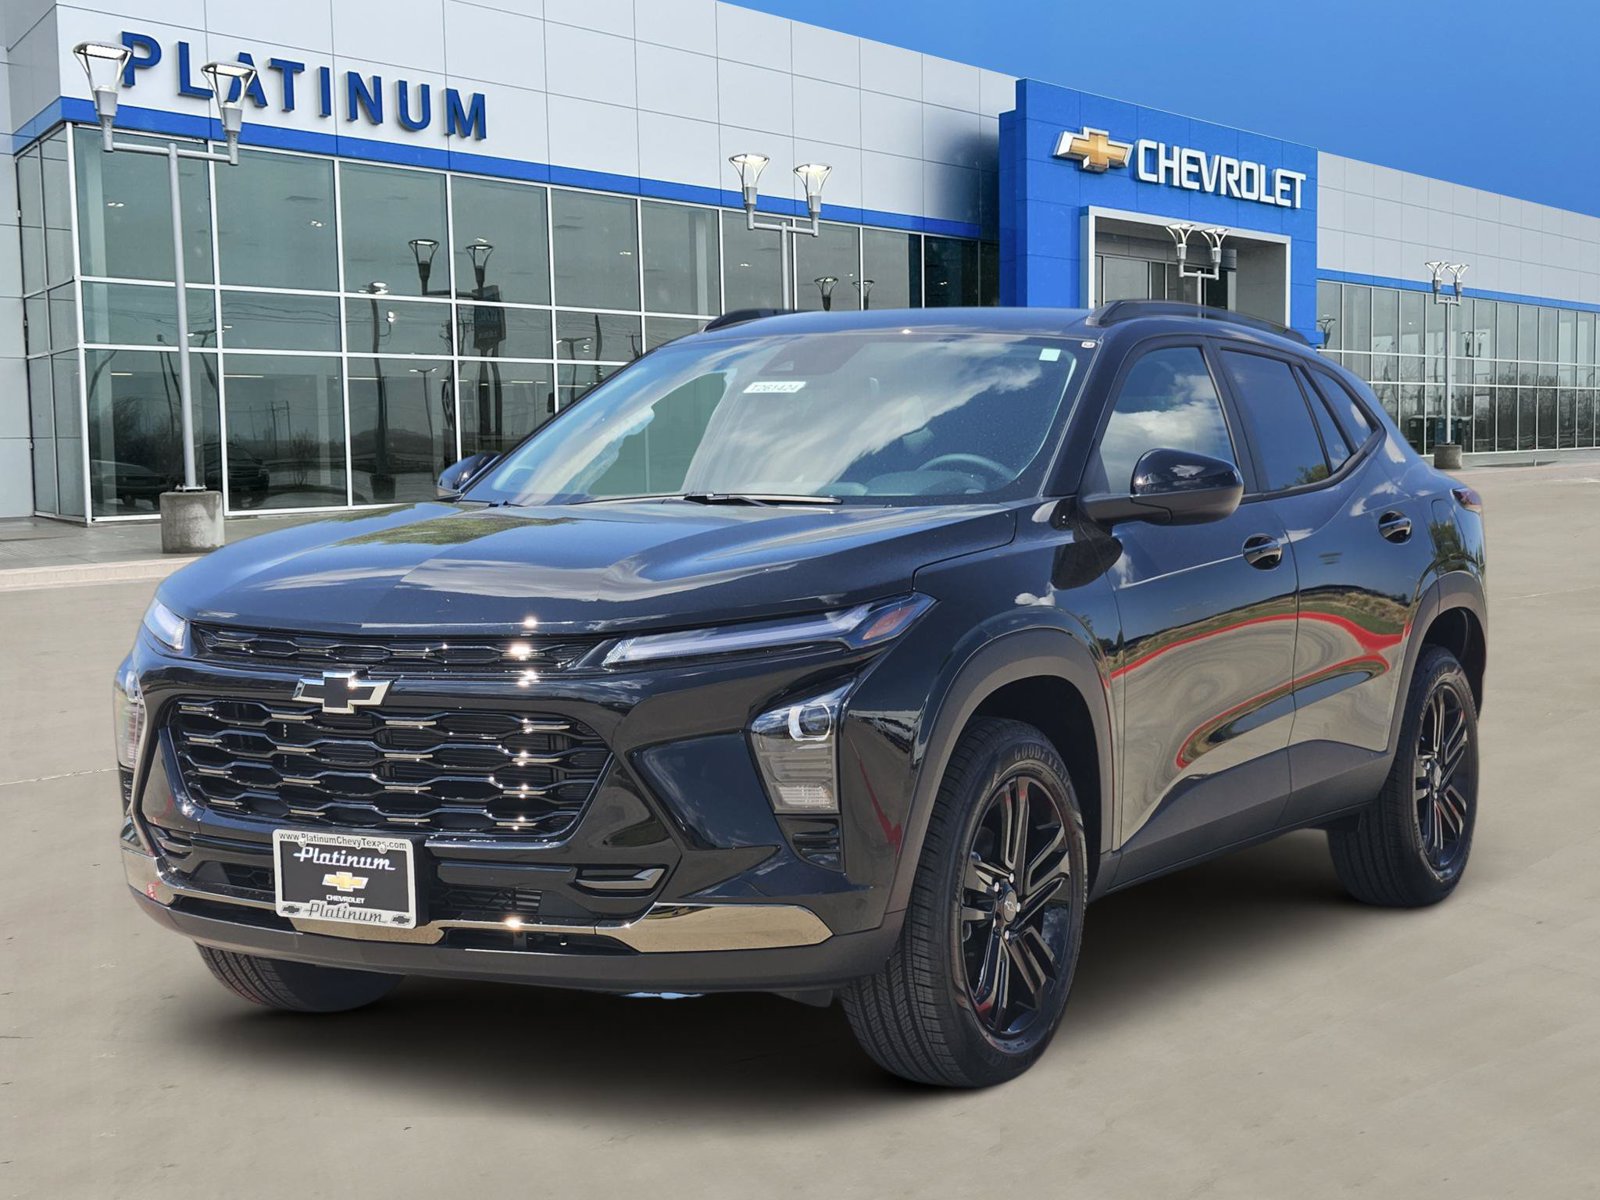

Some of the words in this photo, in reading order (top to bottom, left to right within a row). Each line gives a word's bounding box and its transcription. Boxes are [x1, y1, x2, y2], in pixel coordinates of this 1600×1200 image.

[121, 31, 487, 141] PLATINUM
[1137, 138, 1306, 209] CHEVROLET
[278, 832, 407, 849] wwwPlatinumChevyTexas.com
[293, 846, 396, 871] Platinum
[326, 894, 366, 904] CHEVROLET
[303, 903, 388, 923] Platinum
